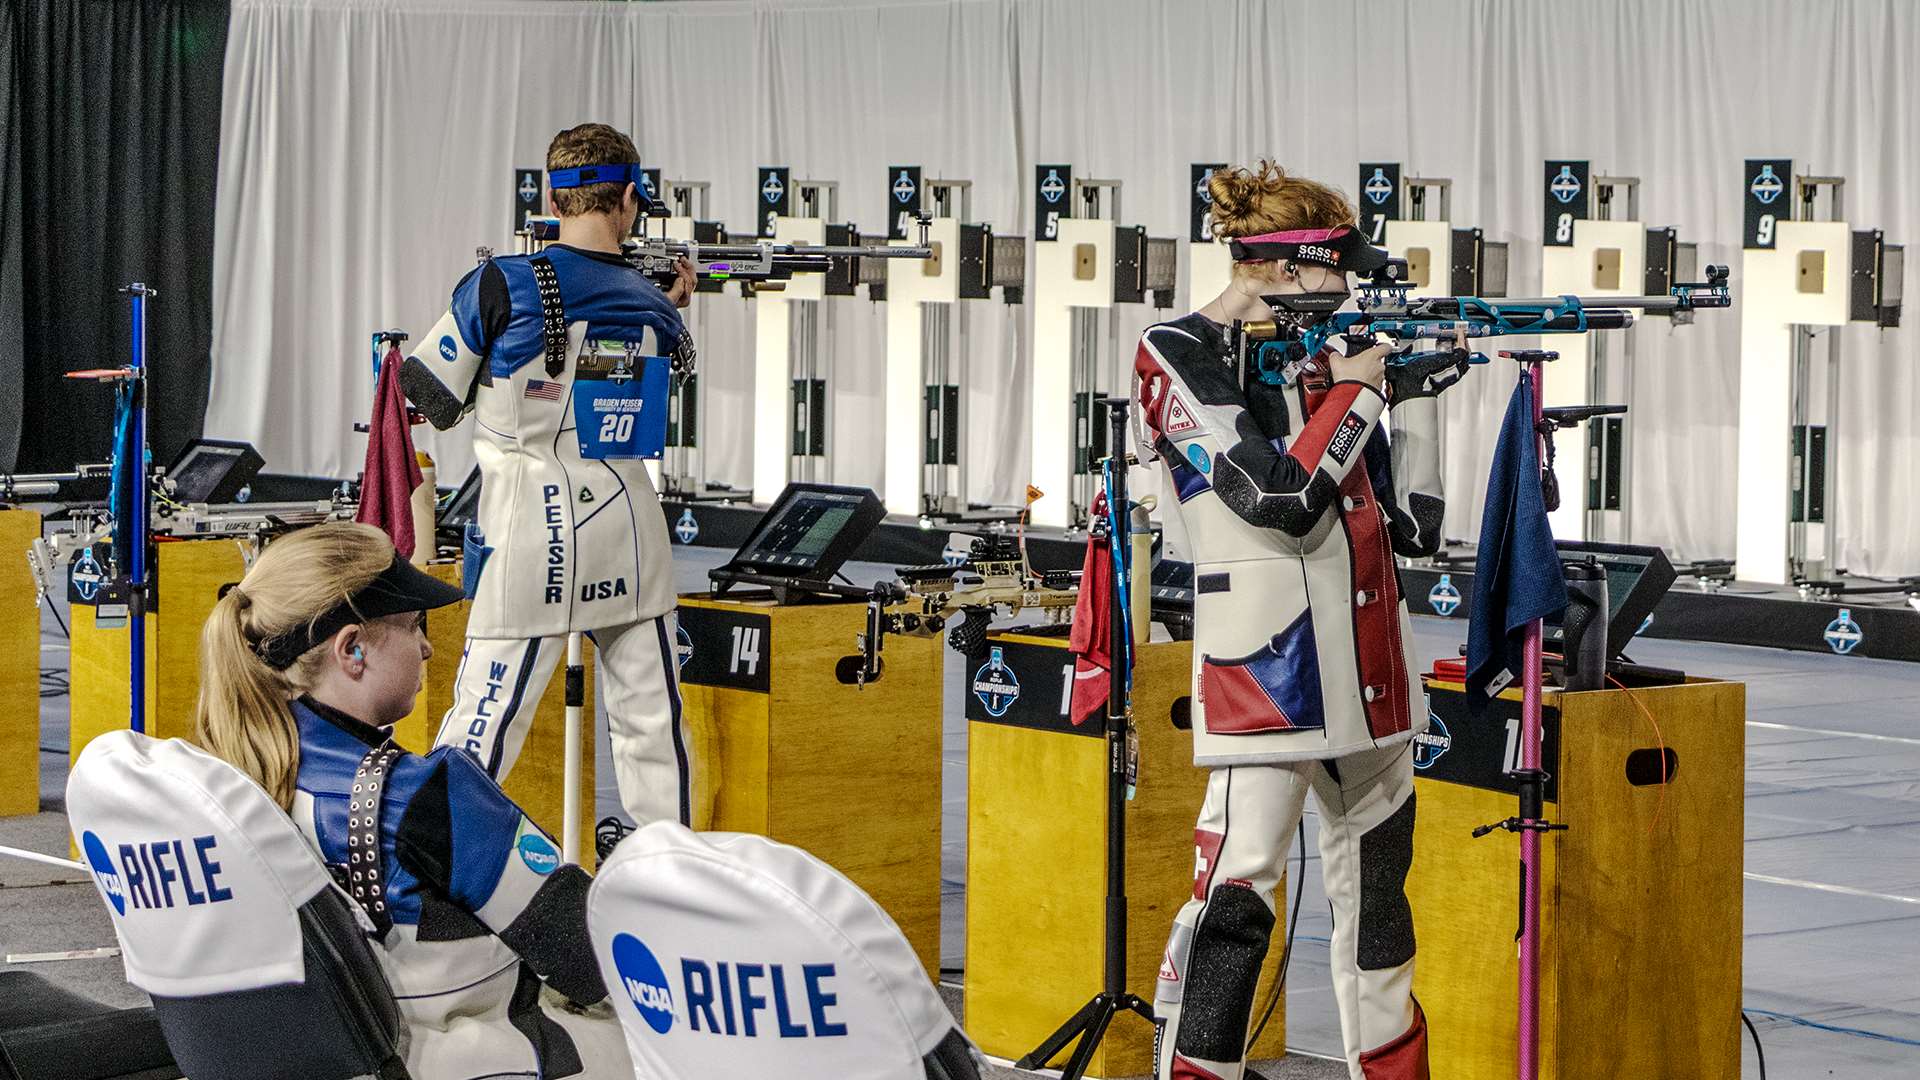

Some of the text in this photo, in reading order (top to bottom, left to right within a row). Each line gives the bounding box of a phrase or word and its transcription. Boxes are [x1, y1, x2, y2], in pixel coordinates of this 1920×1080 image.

[897, 211, 909, 237] 4
[1044, 211, 1059, 238] 5
[1371, 213, 1386, 242] 7
[1555, 213, 1573, 243] 8
[1756, 214, 1775, 245] 9
[1298, 244, 1332, 258] SGSS
[620, 398, 643, 408] PEISER
[599, 414, 635, 443] 20
[1331, 425, 1351, 455] SGSS
[543, 484, 564, 604] PEISER
[581, 578, 627, 602] USA
[730, 626, 760, 675] 14
[975, 681, 1018, 696] CHAMPIONSHIPS
[1060, 664, 1074, 715] 1
[464, 661, 508, 758] WILDC
[1415, 733, 1449, 747] IONSHIPS
[118, 835, 233, 909] RIFLE
[625, 957, 848, 1037] NCAA RIFLE
